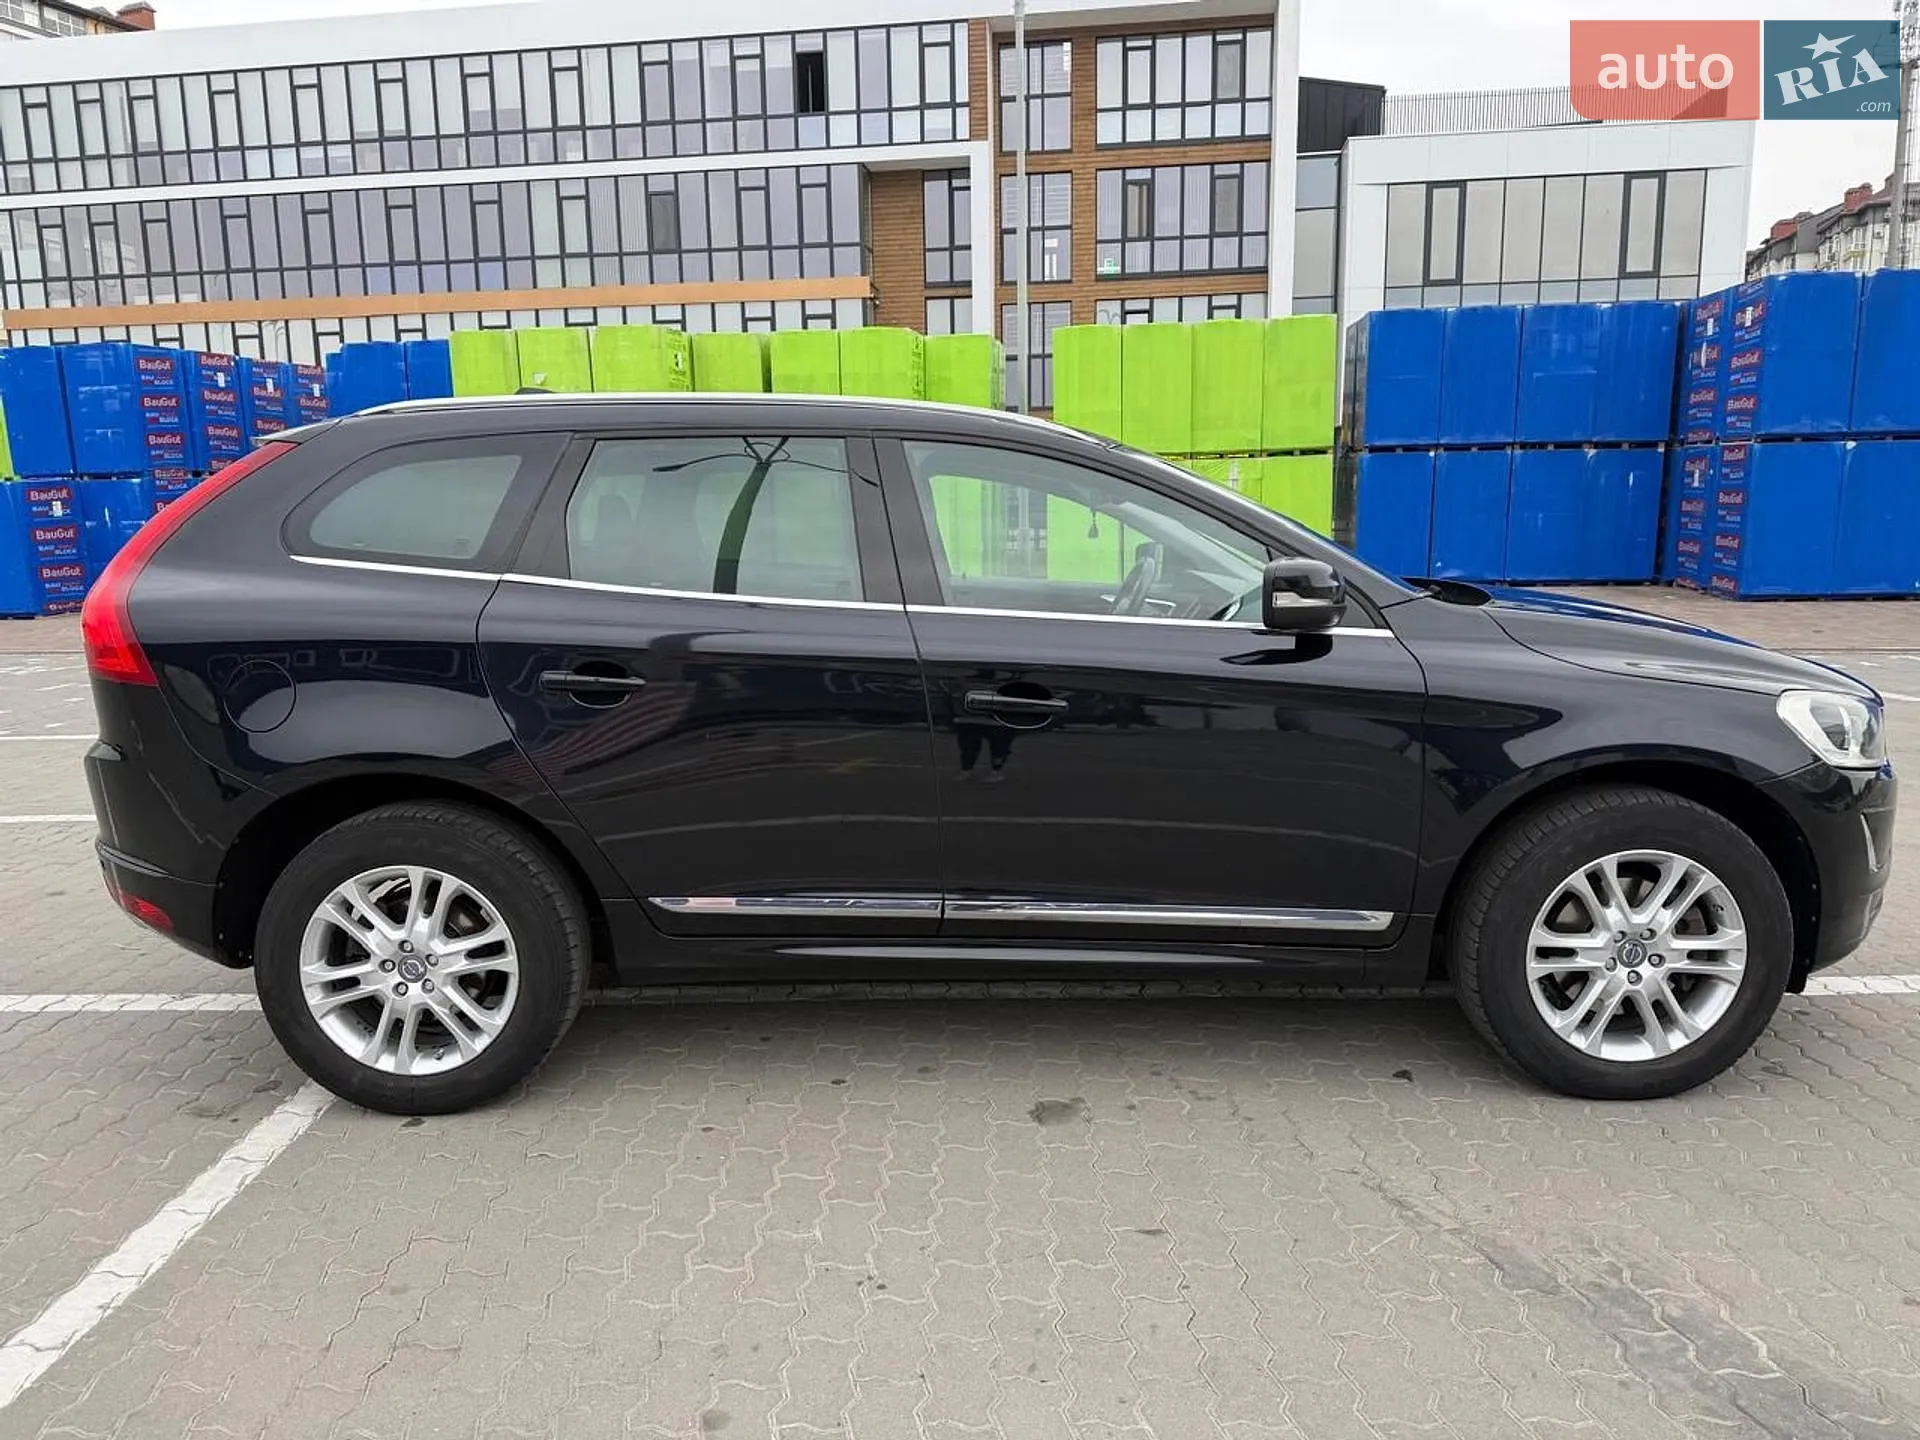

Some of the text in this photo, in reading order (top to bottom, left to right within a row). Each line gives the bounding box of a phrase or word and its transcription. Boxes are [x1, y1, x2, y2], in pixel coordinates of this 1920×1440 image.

[139, 359, 172, 370] BauGut
[143, 397, 178, 407] BauGut
[207, 426, 238, 438] BauGut
[148, 434, 182, 445] BauGut
[30, 488, 69, 501] BauGut
[35, 527, 75, 540] BauGut
[42, 567, 82, 578] BauGut
